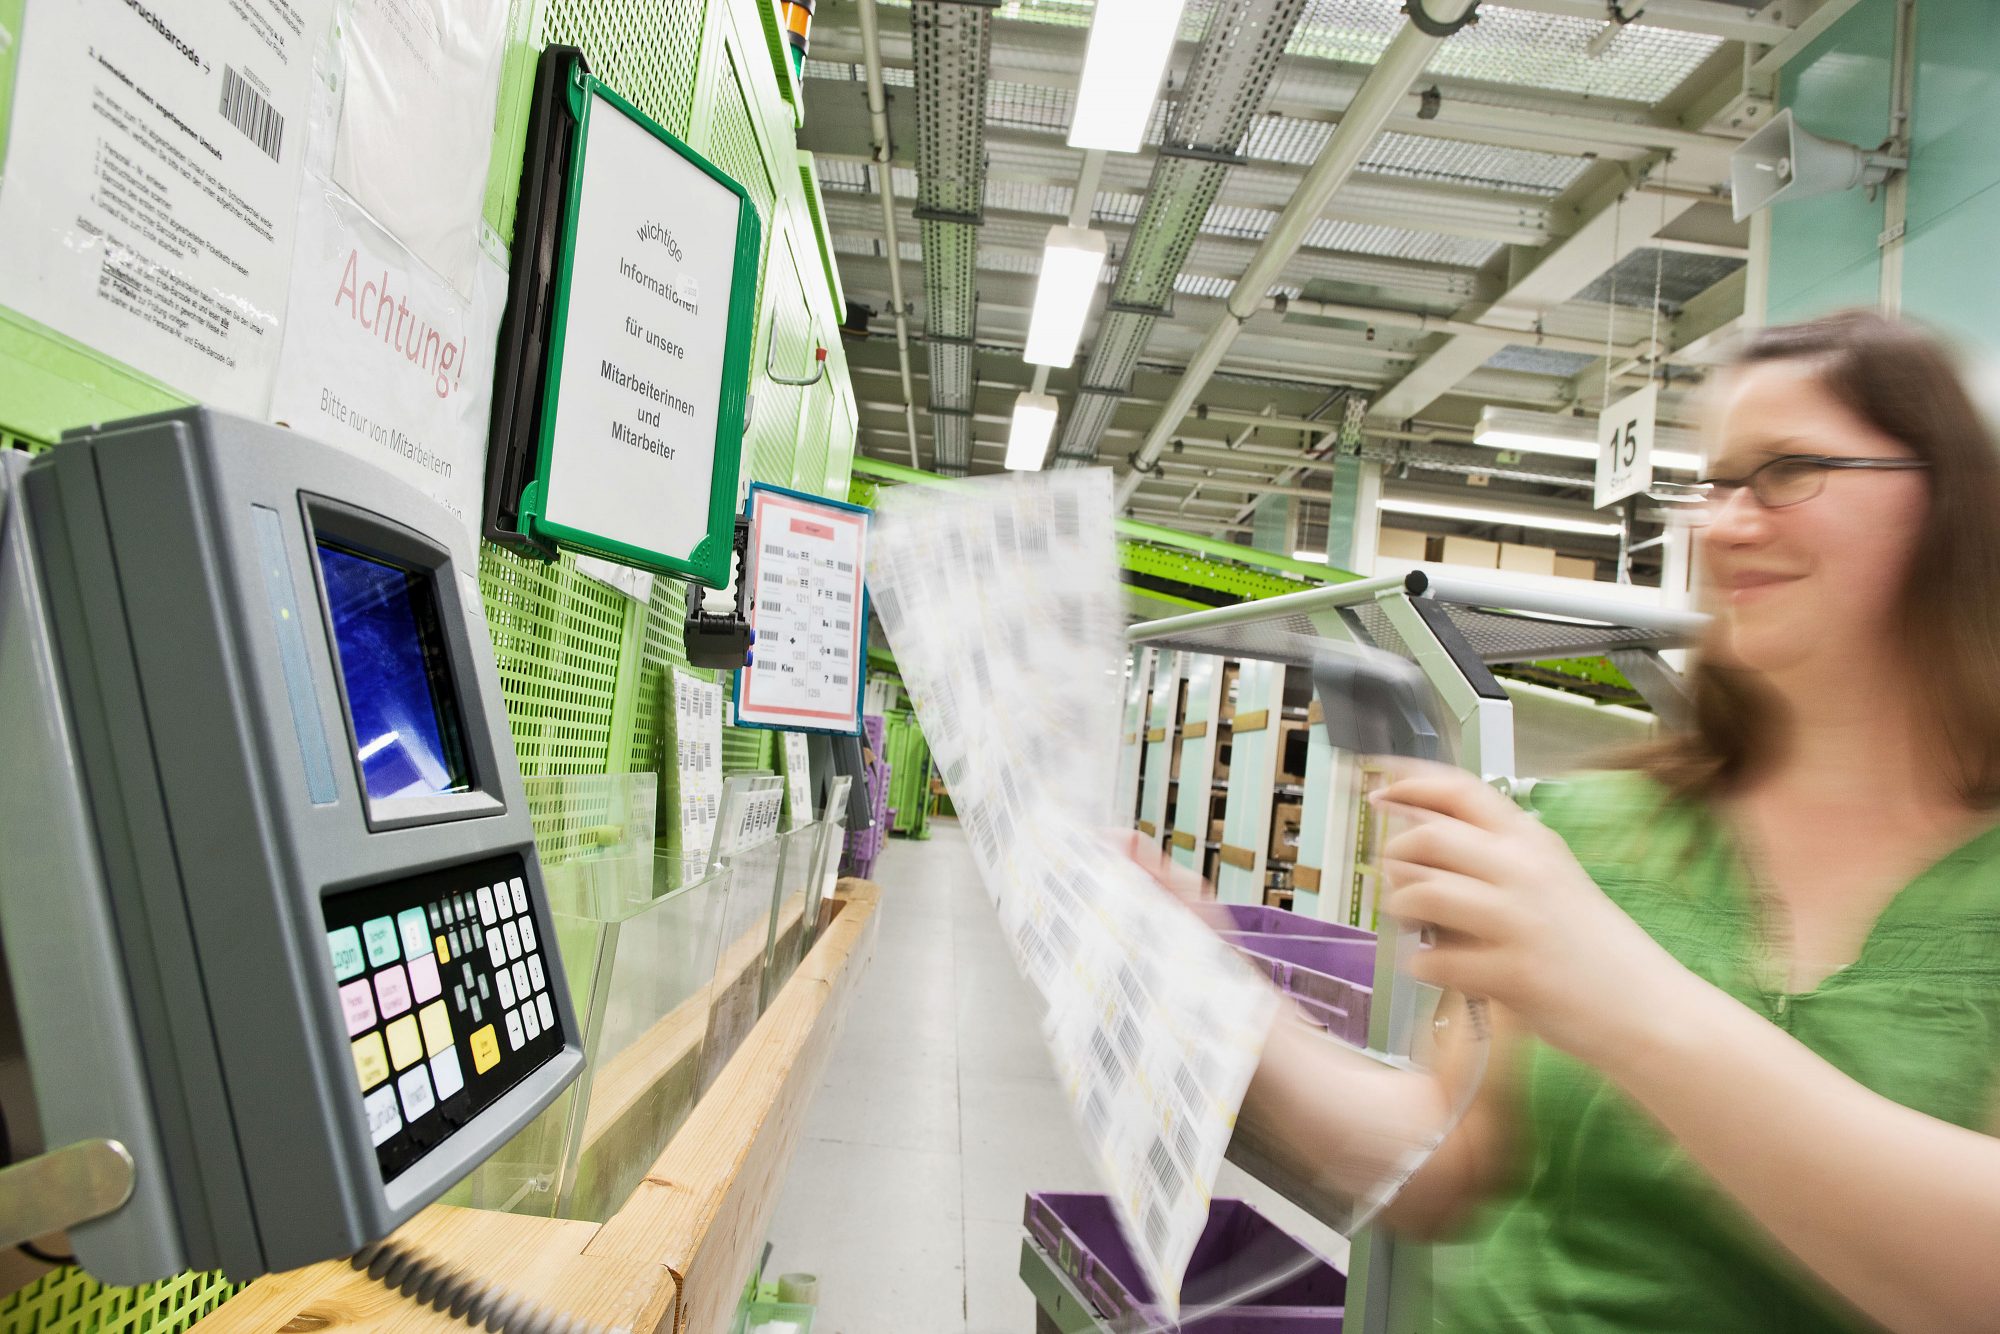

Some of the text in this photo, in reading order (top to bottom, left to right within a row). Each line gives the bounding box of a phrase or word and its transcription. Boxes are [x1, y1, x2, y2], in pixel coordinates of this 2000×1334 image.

[636, 220, 683, 262] wichtige
[334, 248, 467, 399] Achtung!
[625, 316, 685, 360] für unsere
[600, 360, 695, 417] Mitarbeiterinnen
[320, 387, 453, 479] Bitte nur von Mitarbeitern
[611, 421, 676, 461] Mitarbeiter
[637, 408, 661, 428] und
[1610, 419, 1637, 473] 15
